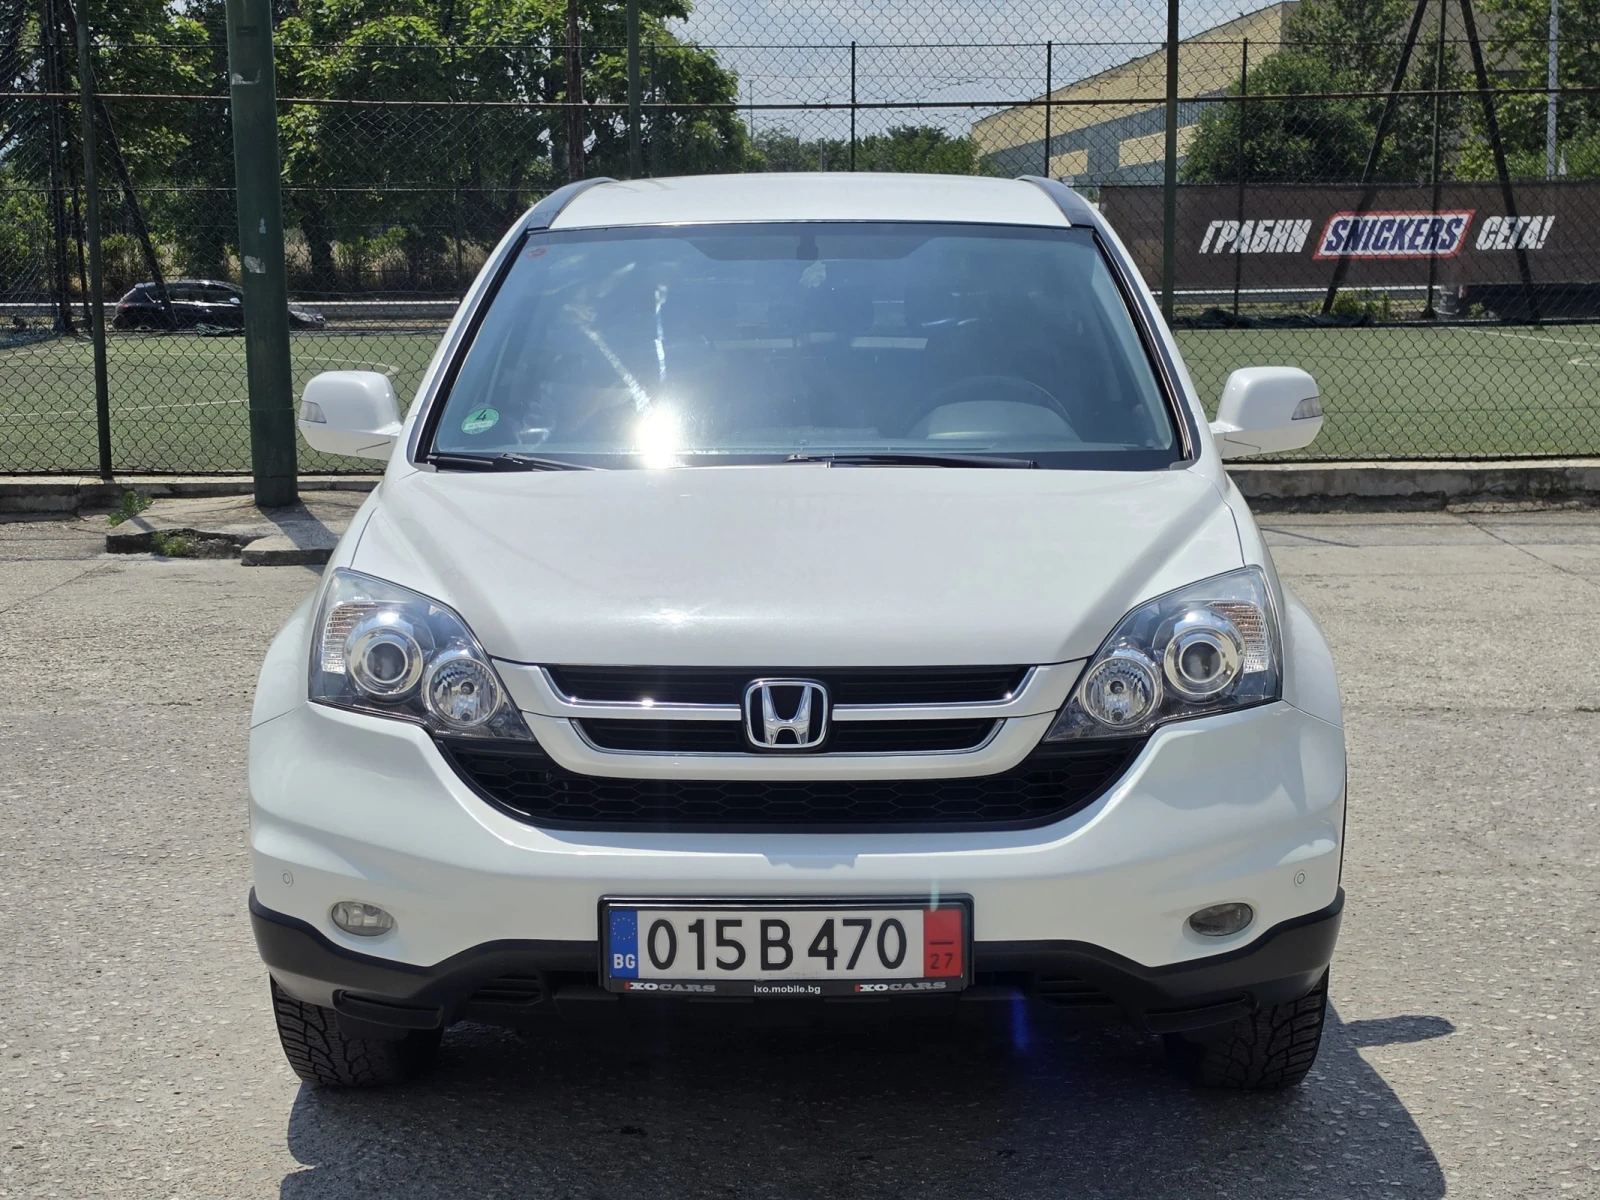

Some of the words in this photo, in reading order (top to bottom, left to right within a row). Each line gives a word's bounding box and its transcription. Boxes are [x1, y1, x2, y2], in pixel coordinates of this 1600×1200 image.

[1199, 219, 1312, 253] ГРАБНИ
[1324, 217, 1464, 252] SNICKERS
[1475, 215, 1556, 250] СЕГА!
[475, 409, 487, 421] 4
[613, 953, 637, 969] BG
[930, 952, 954, 970] 27
[753, 984, 821, 995] ixo.mobile.bg
